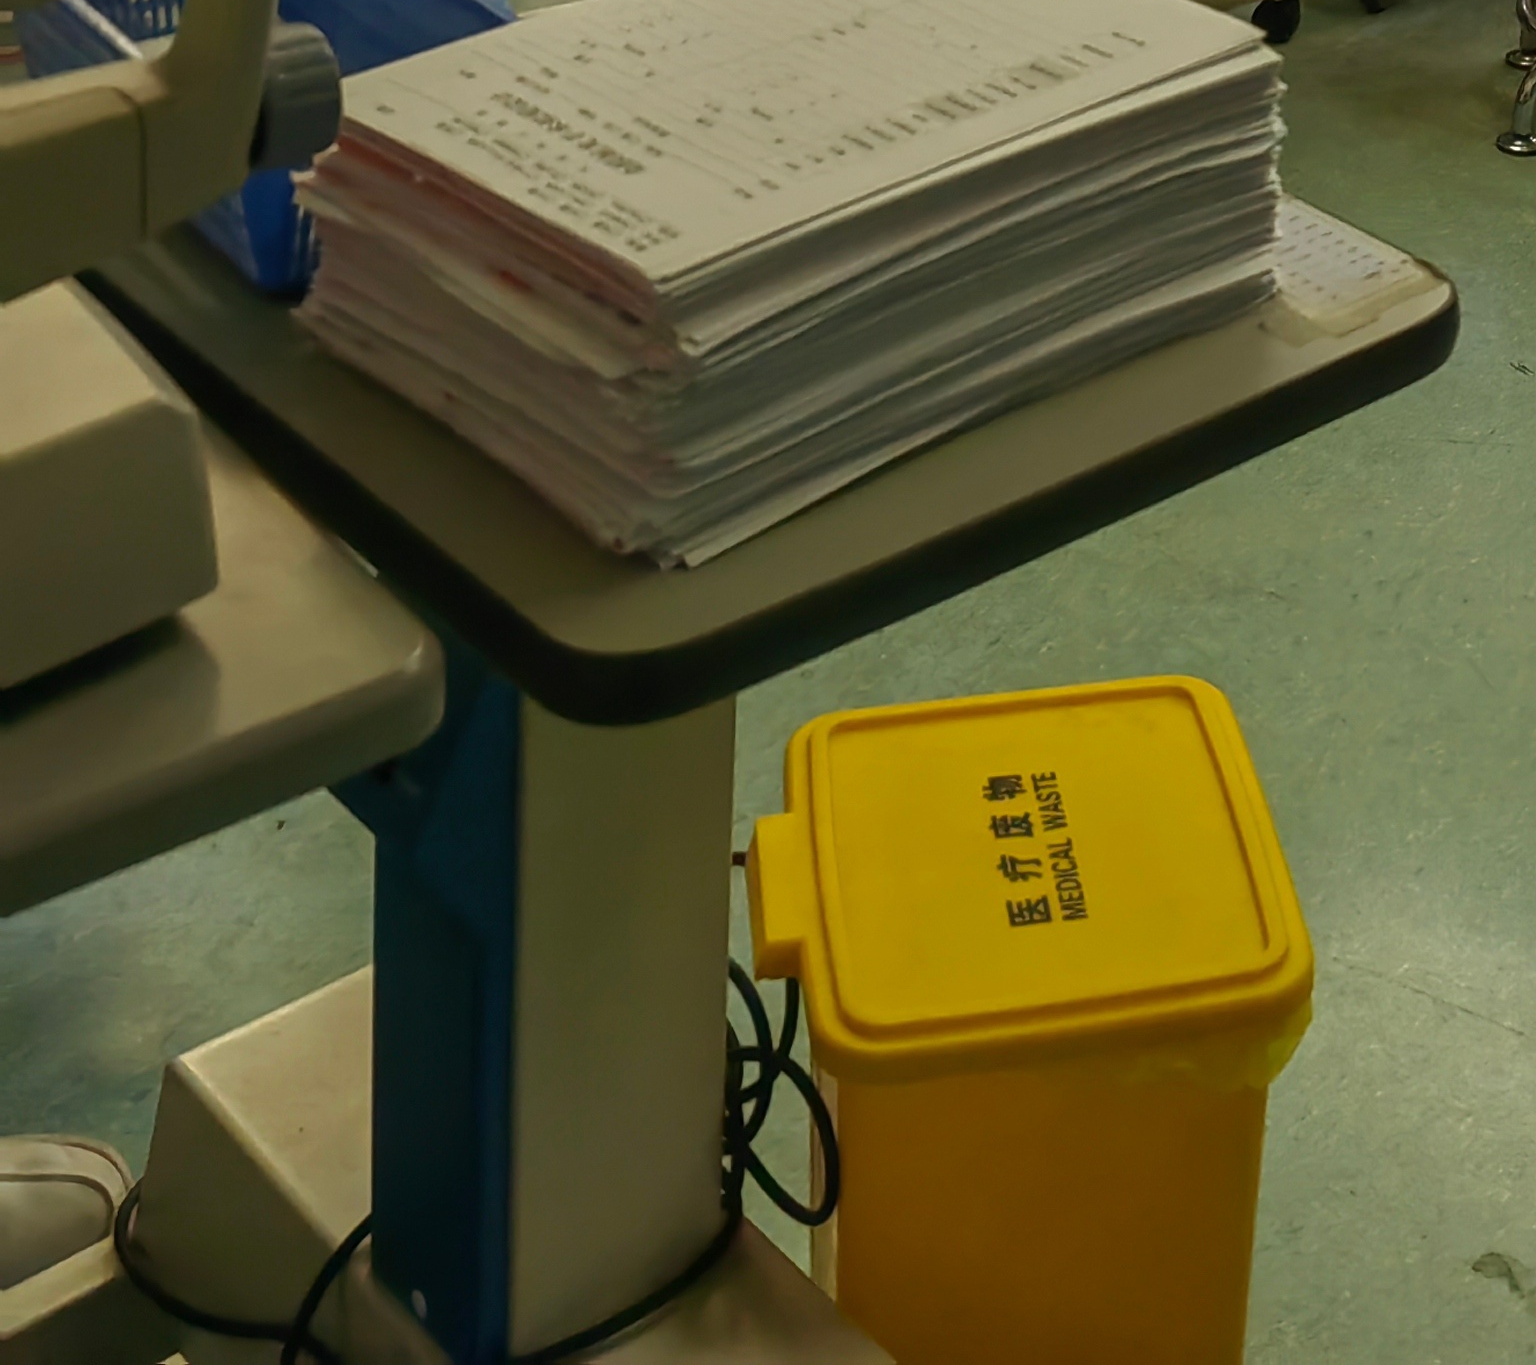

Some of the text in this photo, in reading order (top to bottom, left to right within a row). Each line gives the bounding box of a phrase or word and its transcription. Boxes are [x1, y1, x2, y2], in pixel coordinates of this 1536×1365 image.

[983, 775, 1052, 927] 医疗废物
[1031, 772, 1088, 921] MEDICAL WASTE
